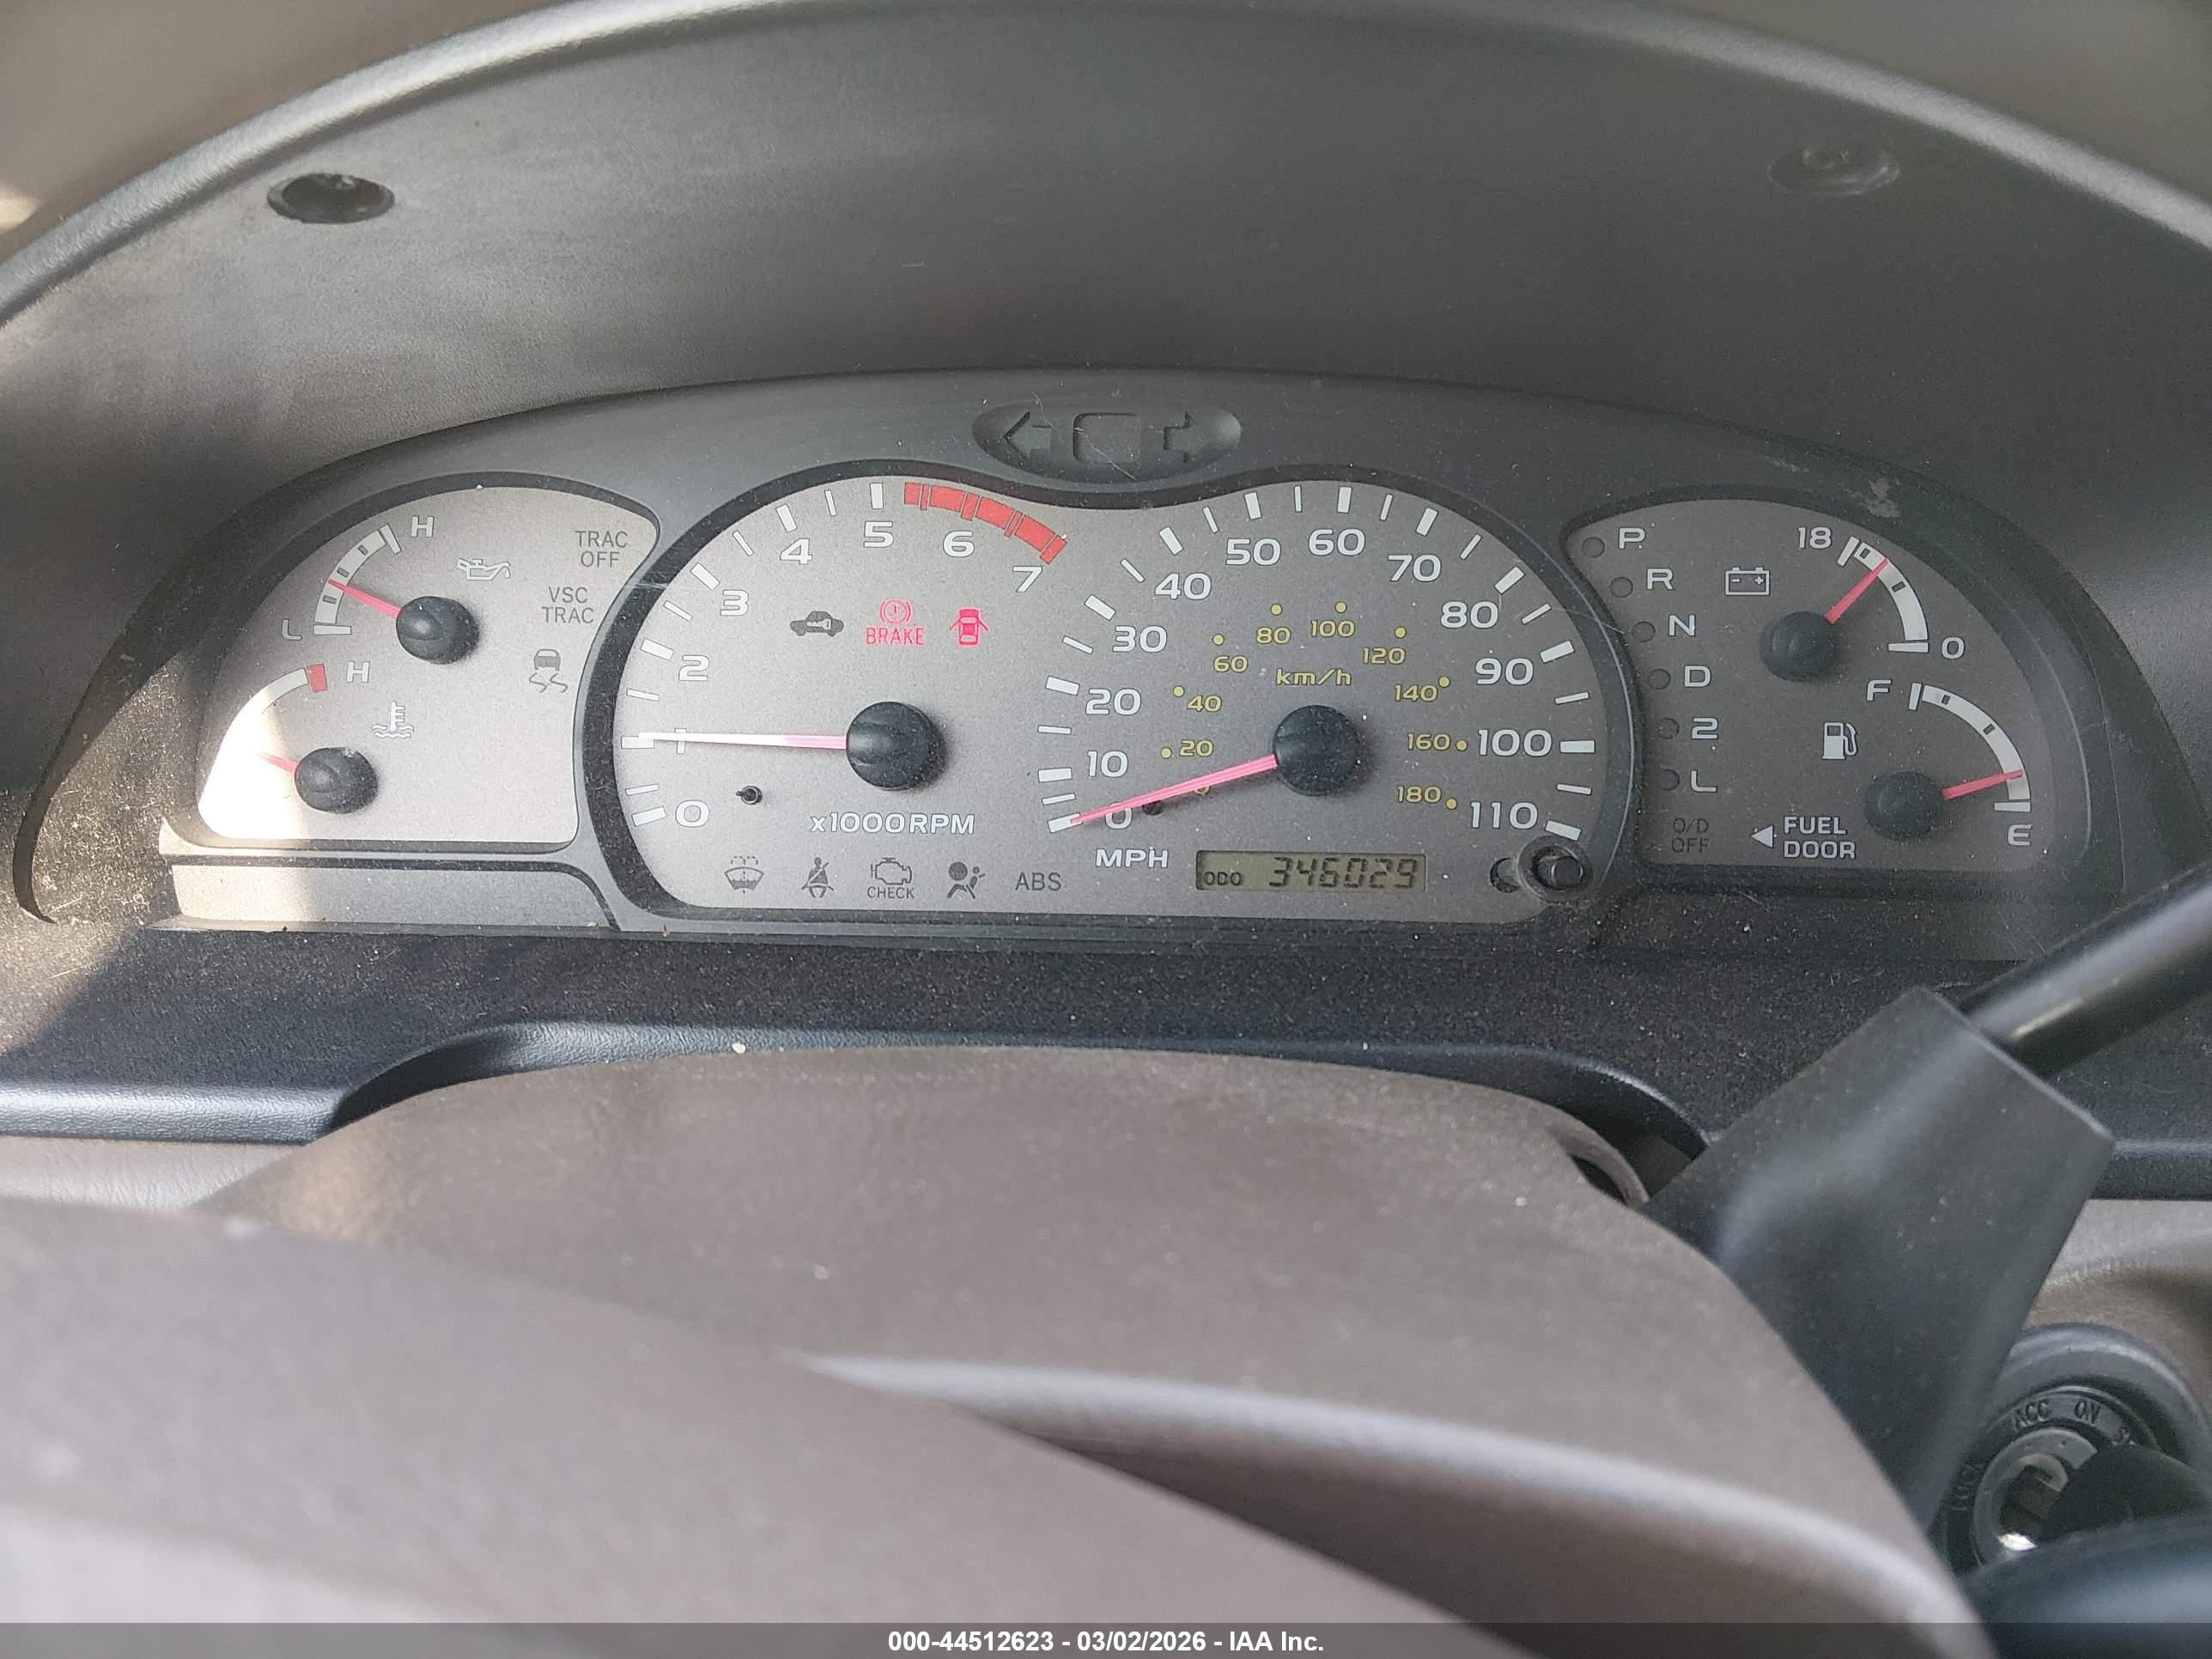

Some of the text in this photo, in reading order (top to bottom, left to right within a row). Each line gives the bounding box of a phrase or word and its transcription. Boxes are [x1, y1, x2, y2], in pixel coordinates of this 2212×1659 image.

[410, 516, 434, 537] H
[864, 521, 893, 548] 5
[1798, 526, 1832, 549] 18
[575, 531, 628, 547] TRAC
[943, 531, 975, 556] 6
[1308, 529, 1365, 556] 60
[1618, 528, 1646, 549] P
[580, 551, 620, 568] OFF
[780, 539, 812, 564] 4
[1225, 538, 1281, 566] 50
[1388, 554, 1442, 581] 70
[1012, 566, 1042, 592] 7
[1155, 573, 1212, 600] 40
[1646, 568, 1674, 590] R
[548, 586, 588, 604] VSC
[720, 590, 750, 616] 3
[542, 607, 594, 623] TRAC
[1441, 601, 1498, 629] 80
[1668, 615, 1696, 636] N
[282, 618, 301, 641] L
[866, 626, 925, 646] BRAKE
[1113, 626, 1167, 653] 30
[1255, 627, 1291, 645] 80
[1310, 620, 1355, 638] 100
[1213, 655, 1249, 673] 60
[1362, 647, 1406, 665] 120
[347, 661, 370, 683] H
[678, 655, 708, 681] 2
[1276, 669, 1352, 686] km/h
[1474, 658, 1534, 685] 90
[1684, 665, 1711, 688] D
[1085, 688, 1141, 715] 20
[1395, 684, 1438, 702] 140
[1867, 680, 1891, 702] F
[1187, 695, 1222, 713] 40
[1691, 718, 1718, 740] 2
[1179, 739, 1213, 757] 20
[1407, 733, 1451, 751] 160
[1477, 729, 1553, 757] 100
[1086, 750, 1128, 777] 10
[1690, 770, 1717, 792] L
[1396, 786, 1442, 804] 180
[675, 801, 709, 828] 0
[1105, 801, 1133, 830] 0
[1470, 802, 1538, 830] 110
[1673, 817, 1710, 834] O/D
[1784, 817, 1846, 836] FUEL
[2008, 824, 2032, 846] E
[1671, 837, 1711, 853] OFF
[1784, 841, 1856, 860] DOOR
[1095, 849, 1169, 869] MPH
[1016, 872, 1062, 891] ABS
[1203, 857, 1419, 889] ODO 346029
[867, 886, 915, 900] CHECK
[2075, 1400, 2102, 1424] ON
